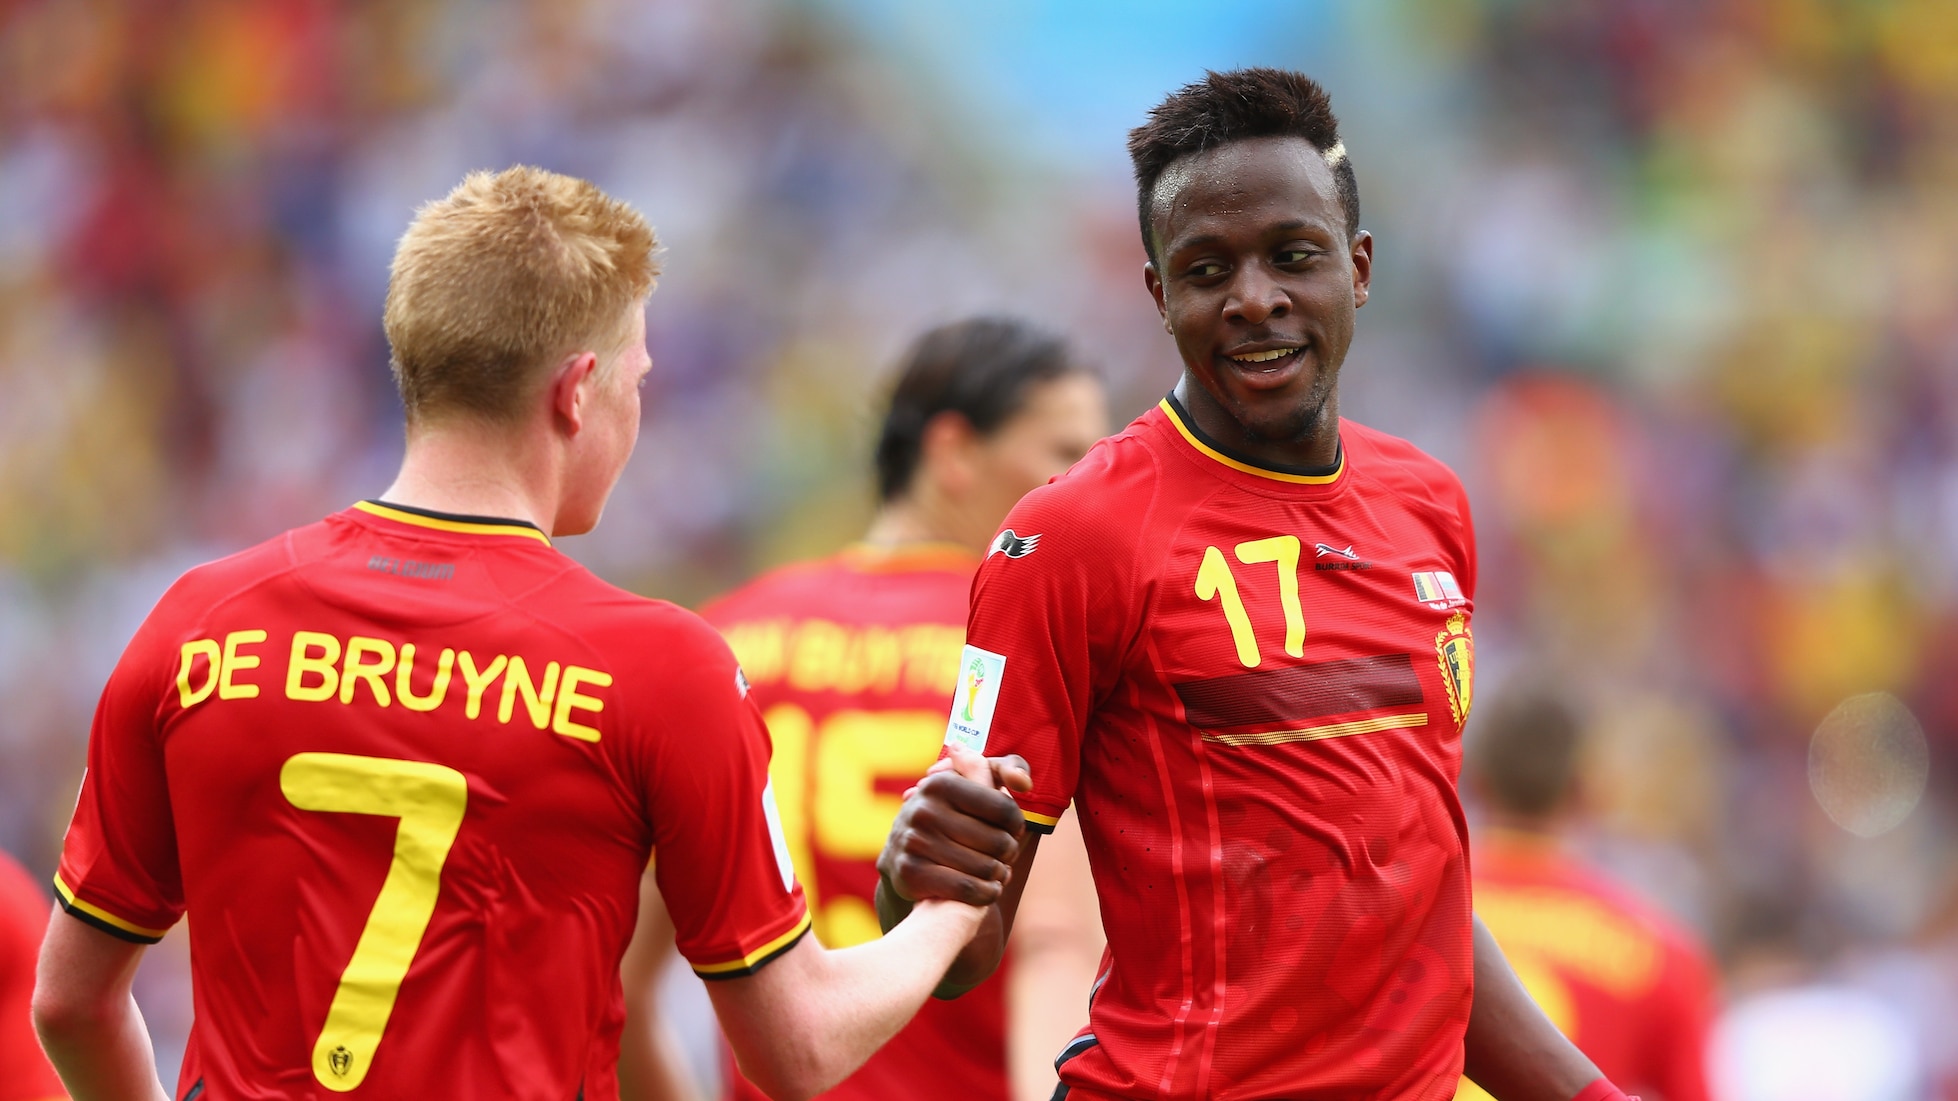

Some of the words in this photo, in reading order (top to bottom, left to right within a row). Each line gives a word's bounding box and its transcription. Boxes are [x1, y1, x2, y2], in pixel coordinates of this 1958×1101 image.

[1194, 535, 1306, 668] 17
[177, 629, 268, 708] DE
[285, 631, 613, 742] BRUYNE
[280, 753, 467, 1092] 7
